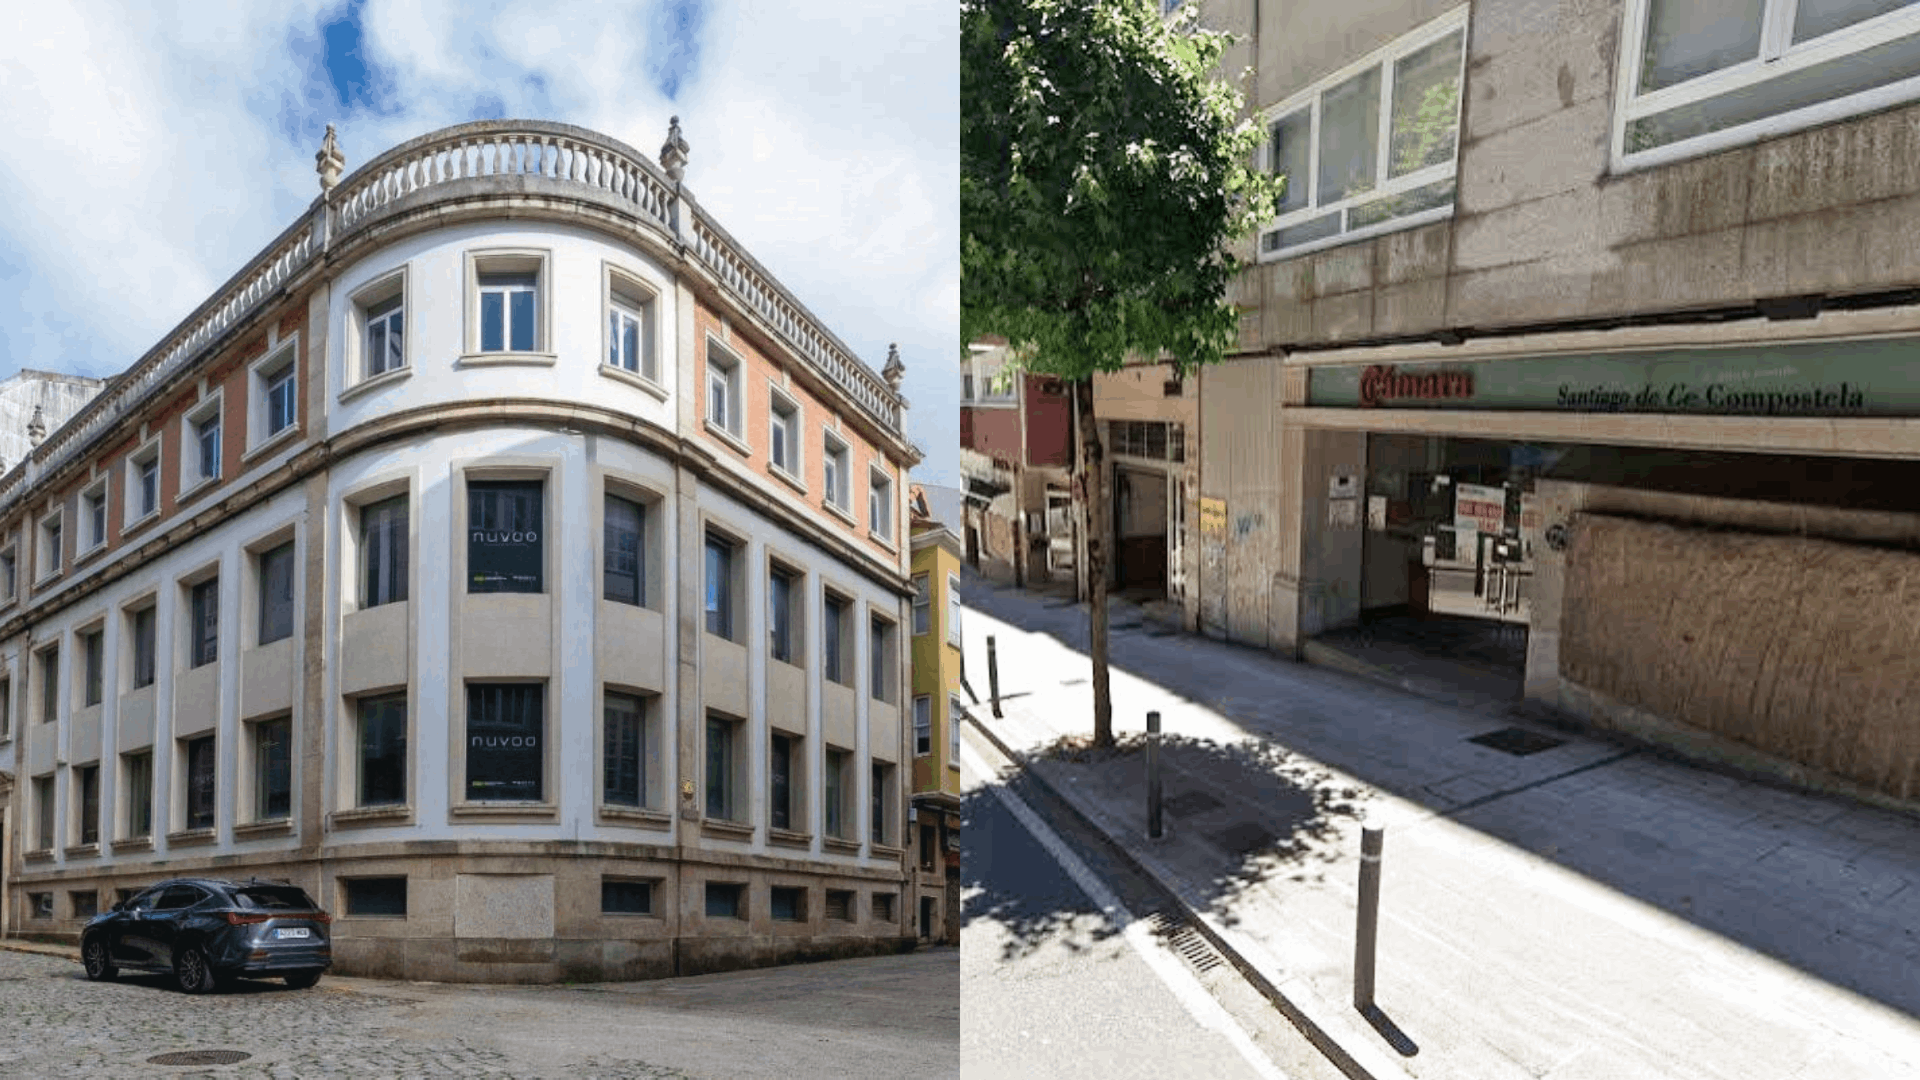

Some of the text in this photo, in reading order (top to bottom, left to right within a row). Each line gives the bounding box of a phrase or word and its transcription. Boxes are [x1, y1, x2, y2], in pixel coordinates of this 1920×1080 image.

[1557, 384, 1631, 411] Santiago
[1635, 384, 1660, 405] de
[1706, 382, 1864, 414] Compostela
[473, 531, 537, 543] nuvoo
[472, 736, 536, 747] nuvoo
